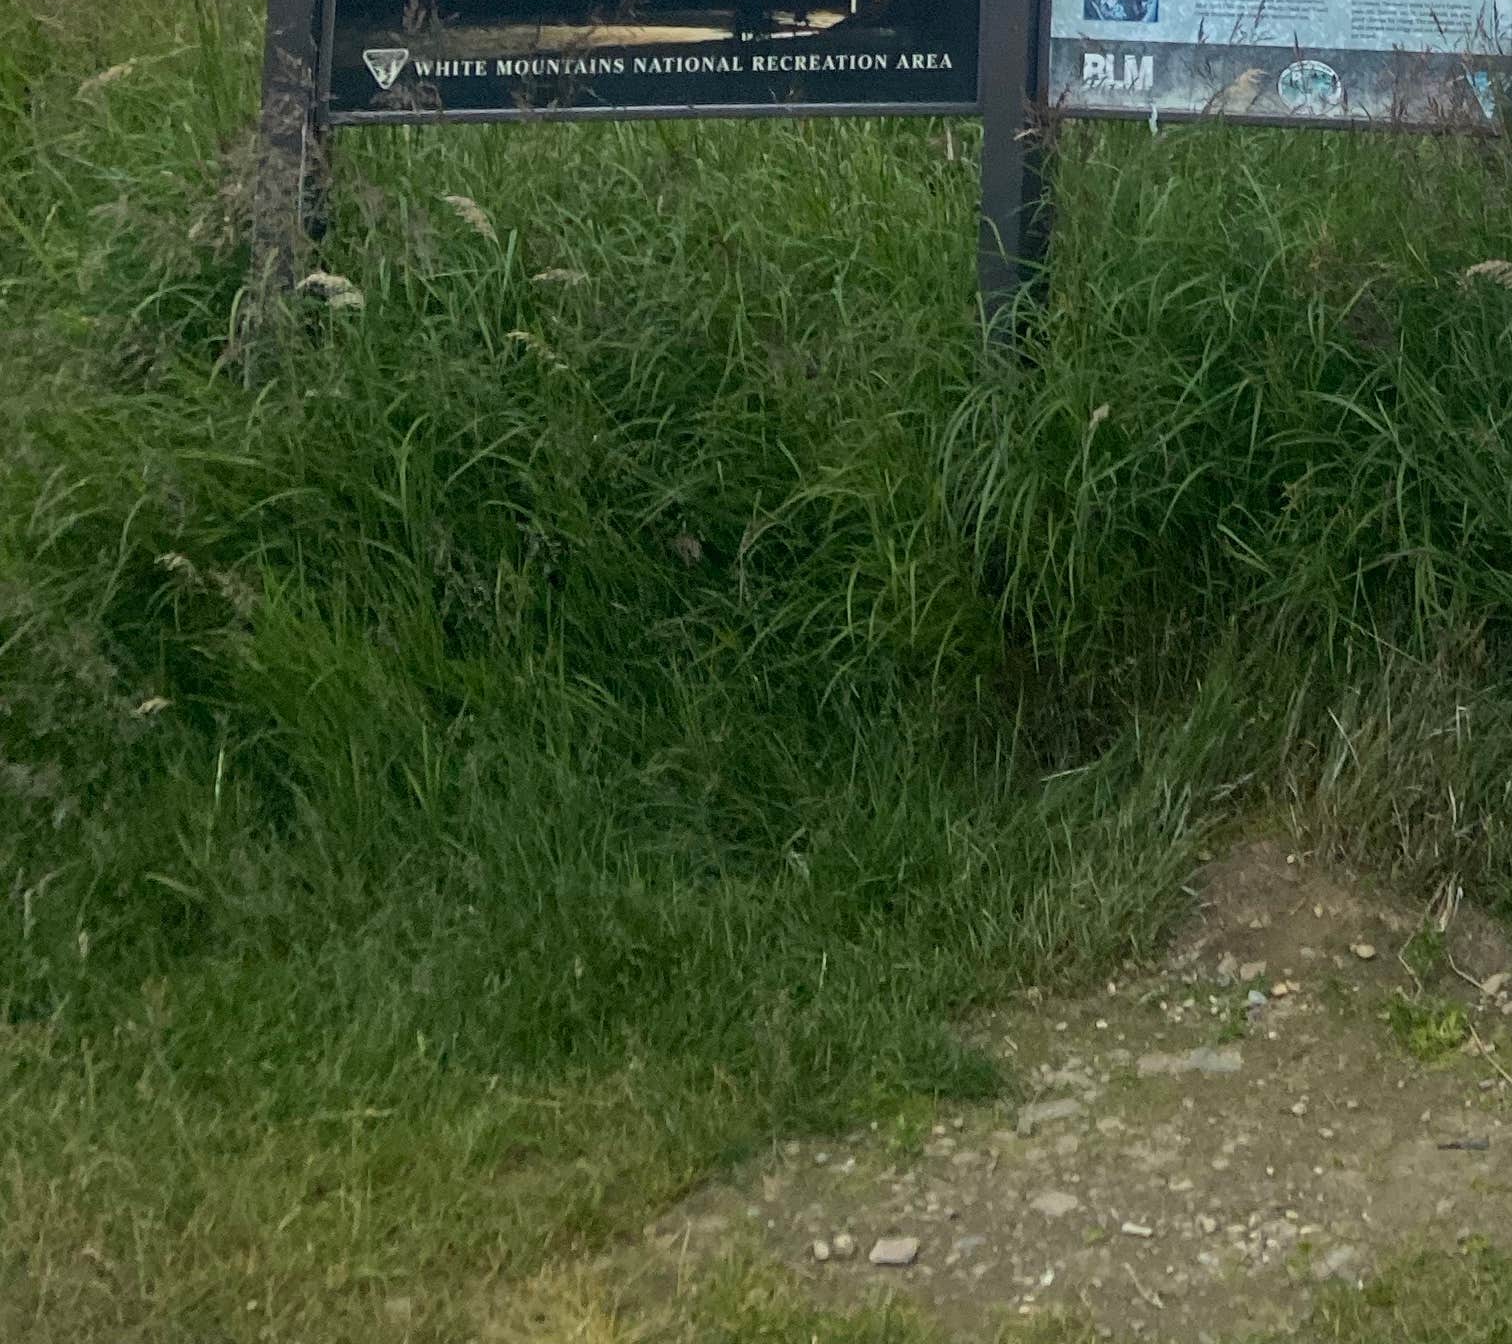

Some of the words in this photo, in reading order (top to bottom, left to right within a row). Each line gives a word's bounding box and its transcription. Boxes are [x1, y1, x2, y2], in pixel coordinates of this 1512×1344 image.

[414, 59, 488, 77] WHITE
[496, 58, 625, 77] MOUNTAINS
[633, 56, 744, 74] NATIONAL
[751, 54, 888, 72] RECREATION
[895, 53, 953, 70] AREA
[1083, 52, 1154, 90] BLM
